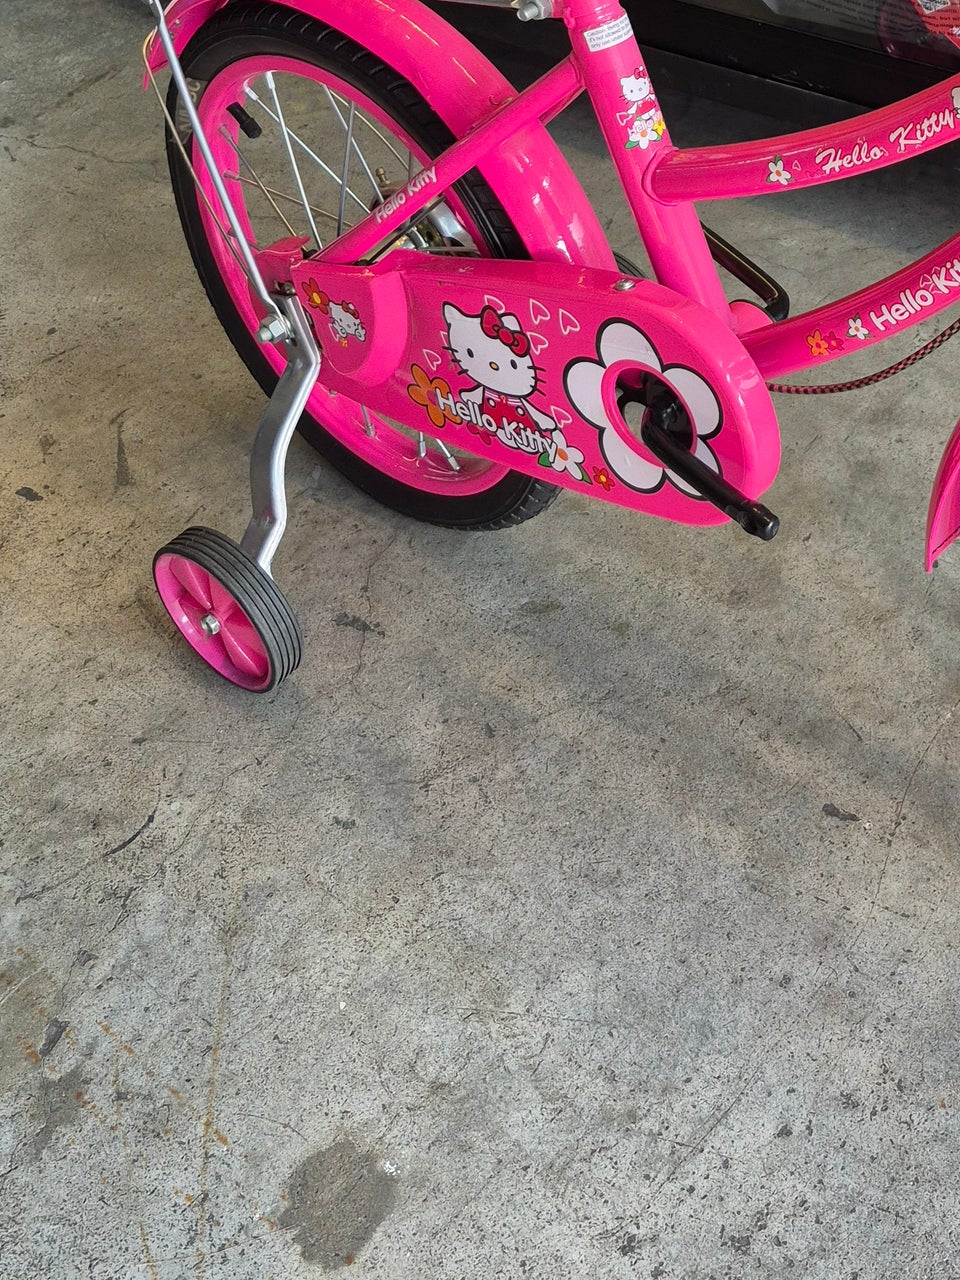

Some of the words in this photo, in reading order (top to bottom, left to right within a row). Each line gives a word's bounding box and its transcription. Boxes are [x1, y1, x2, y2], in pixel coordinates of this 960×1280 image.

[816, 142, 885, 175] Hello
[889, 109, 955, 151] Kitty
[375, 192, 407, 224] Hello
[407, 166, 437, 196] Kitty
[870, 290, 934, 332] Hello
[436, 388, 498, 432] Hello
[504, 423, 558, 465] Kitty
